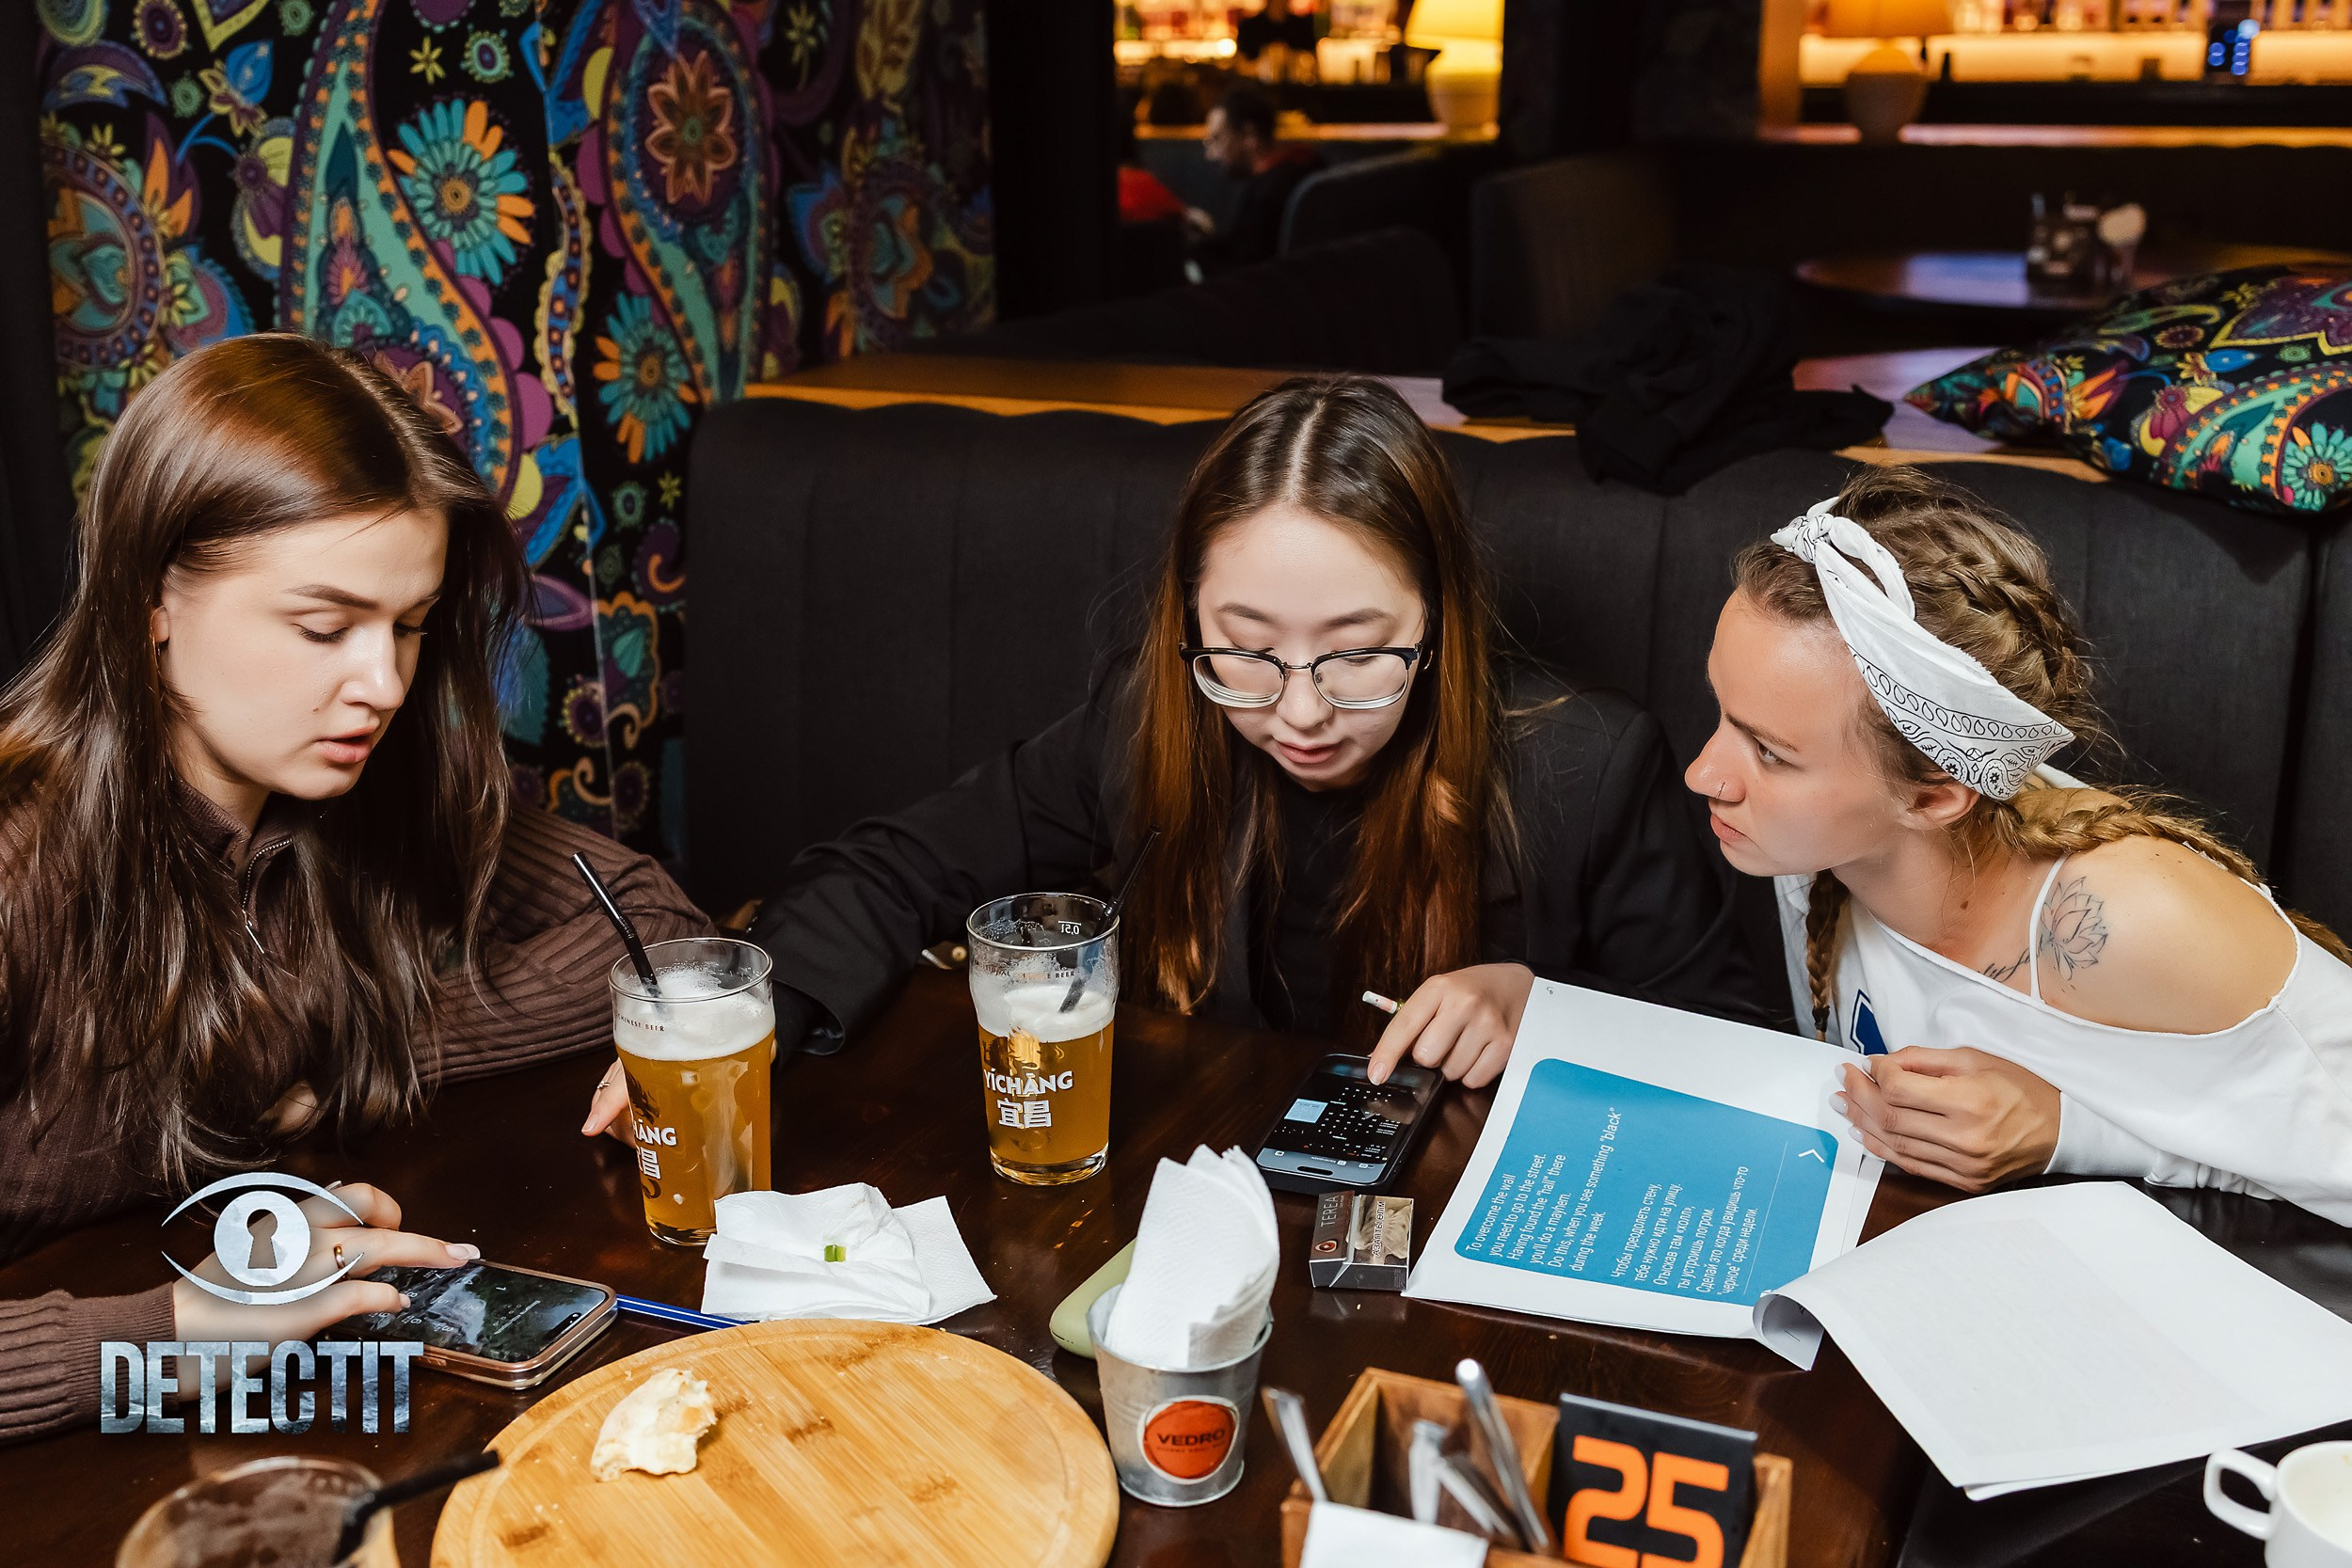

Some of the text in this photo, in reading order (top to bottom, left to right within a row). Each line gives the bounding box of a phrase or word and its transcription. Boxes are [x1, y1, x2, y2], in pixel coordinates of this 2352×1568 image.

[1055, 971, 1075, 979] BEER
[997, 1098, 1052, 1129] 宜昌
[640, 1147, 661, 1180] 昌
[1547, 1154, 1566, 1176] there
[1585, 1144, 1614, 1188] something
[1488, 1154, 1546, 1258] you need to go to the street.
[1531, 1197, 1548, 1210] the
[1573, 1202, 1588, 1217] you
[1580, 1188, 1594, 1202] see
[1320, 1195, 1340, 1227] TEREA
[1465, 1173, 1516, 1251] To overcome the wall
[1518, 1208, 1542, 1233] found
[1538, 1232, 1553, 1243] do
[1548, 1193, 1571, 1226] mayhem.
[1563, 1216, 1581, 1237] when
[1740, 1208, 1757, 1238] недели.
[1372, 1222, 1384, 1257] АЗАПТЫ
[1568, 1212, 1606, 1272] during the week.
[1611, 1183, 1662, 1277] Чтобы преодолеть стену,
[1634, 1183, 1683, 1281] тебе нужно идти на улицу.
[1695, 1165, 1749, 1292] Сделай это когда увидишь что-то
[1506, 1229, 1534, 1260] Having
[1553, 1234, 1574, 1255] this,
[1652, 1251, 1677, 1285] Отыскав
[1668, 1234, 1683, 1249] там
[1677, 1208, 1714, 1289] ты устроишь погром.
[1731, 1238, 1750, 1262] среди
[1547, 1256, 1565, 1268] Do
[1157, 1429, 1226, 1447] VEDRO
[1564, 1435, 1730, 1568] 25
